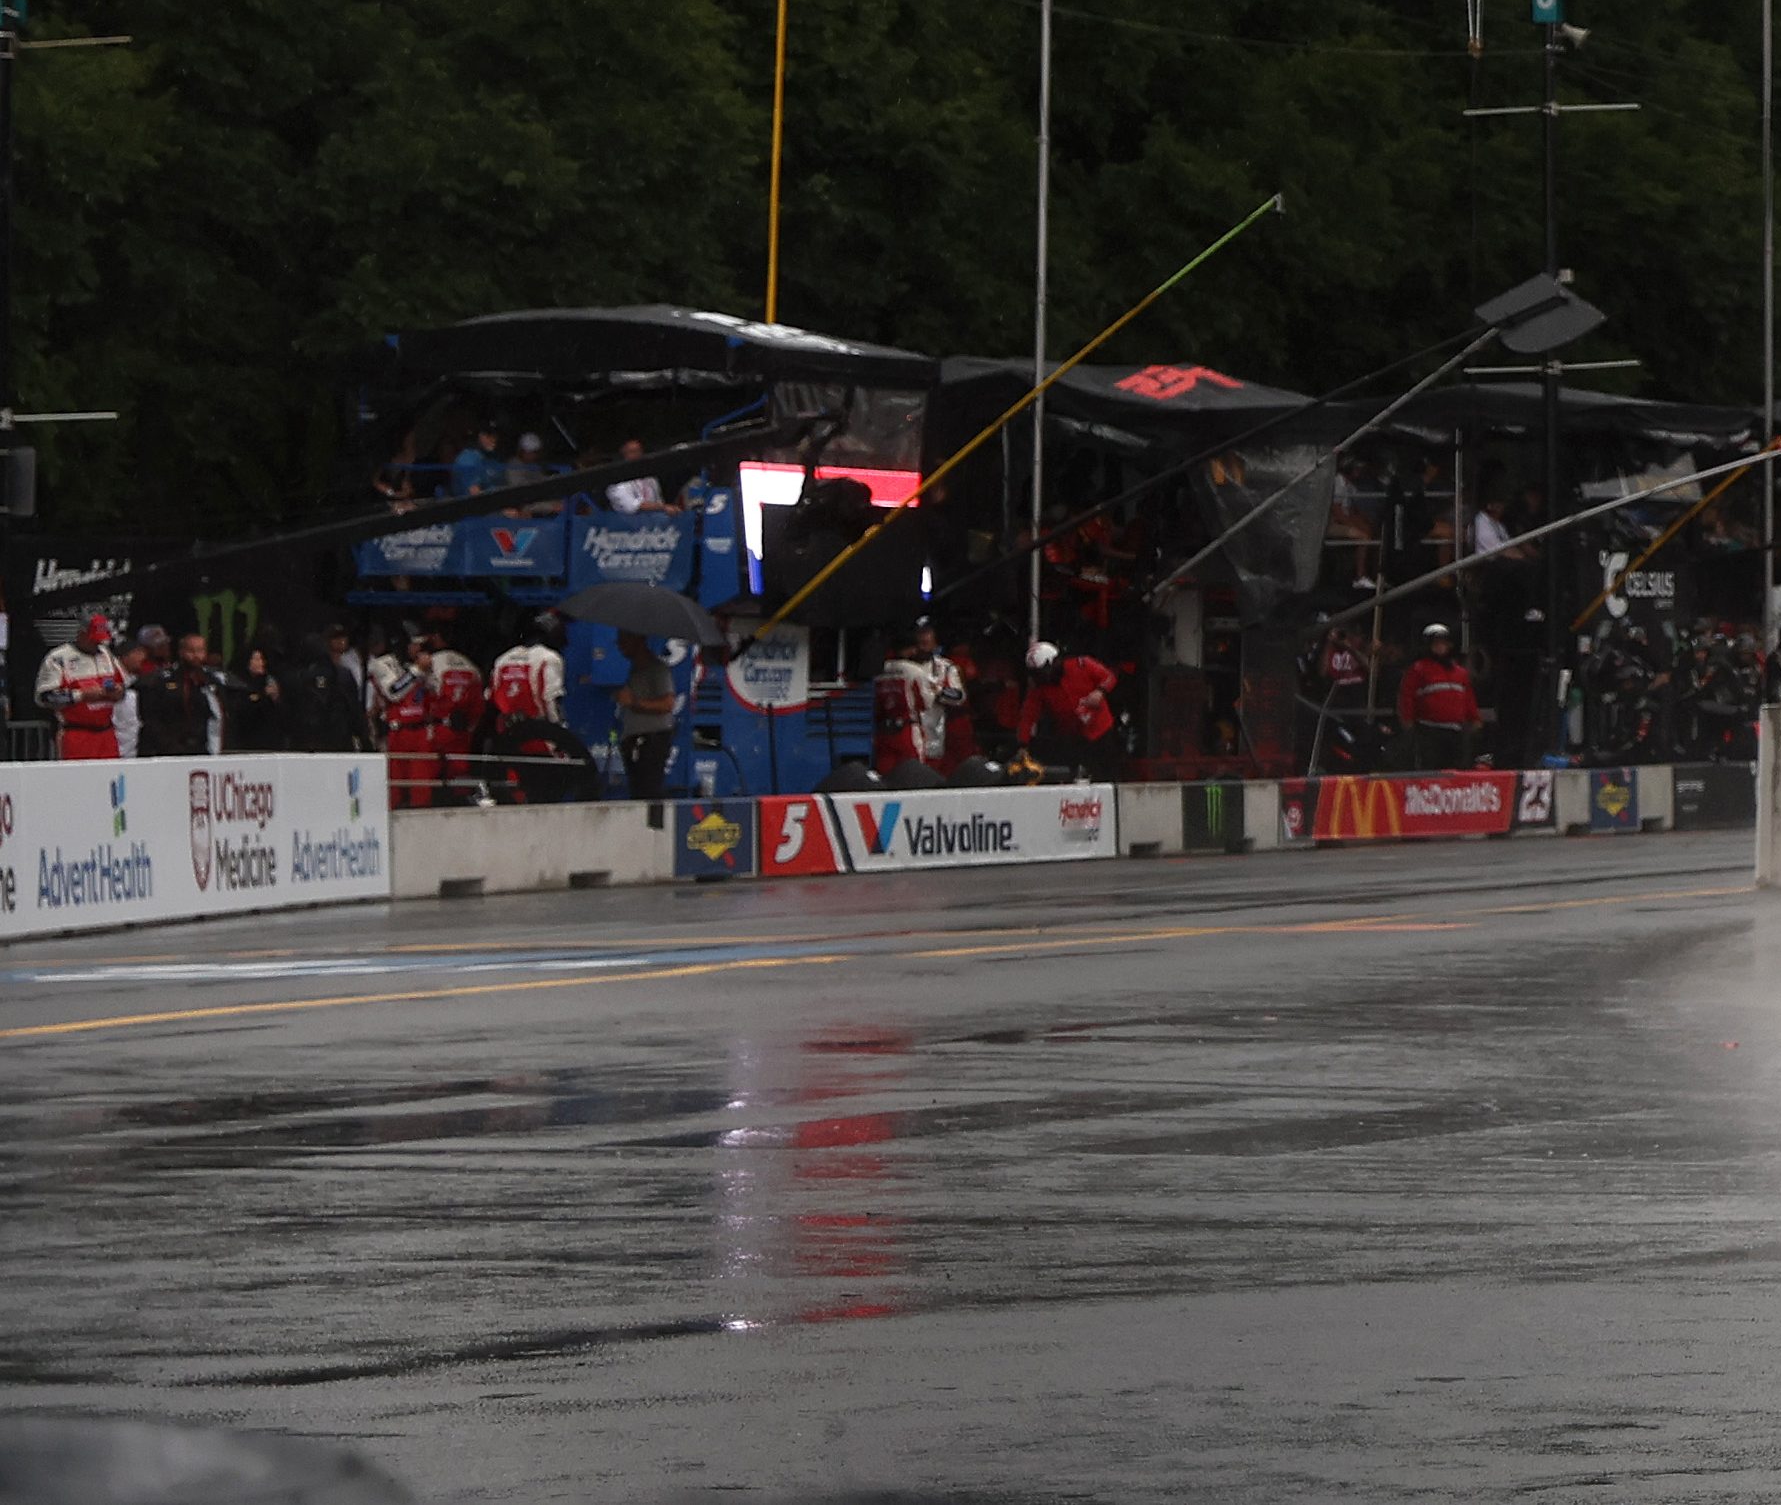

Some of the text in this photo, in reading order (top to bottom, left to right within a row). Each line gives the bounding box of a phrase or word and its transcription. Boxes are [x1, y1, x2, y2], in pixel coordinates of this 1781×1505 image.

[214, 833, 277, 892] Medicine
[290, 826, 381, 882] AdventHealth
[774, 803, 808, 864] 5
[904, 813, 1014, 857] Valvoline
[37, 840, 154, 909] AdventHealth
